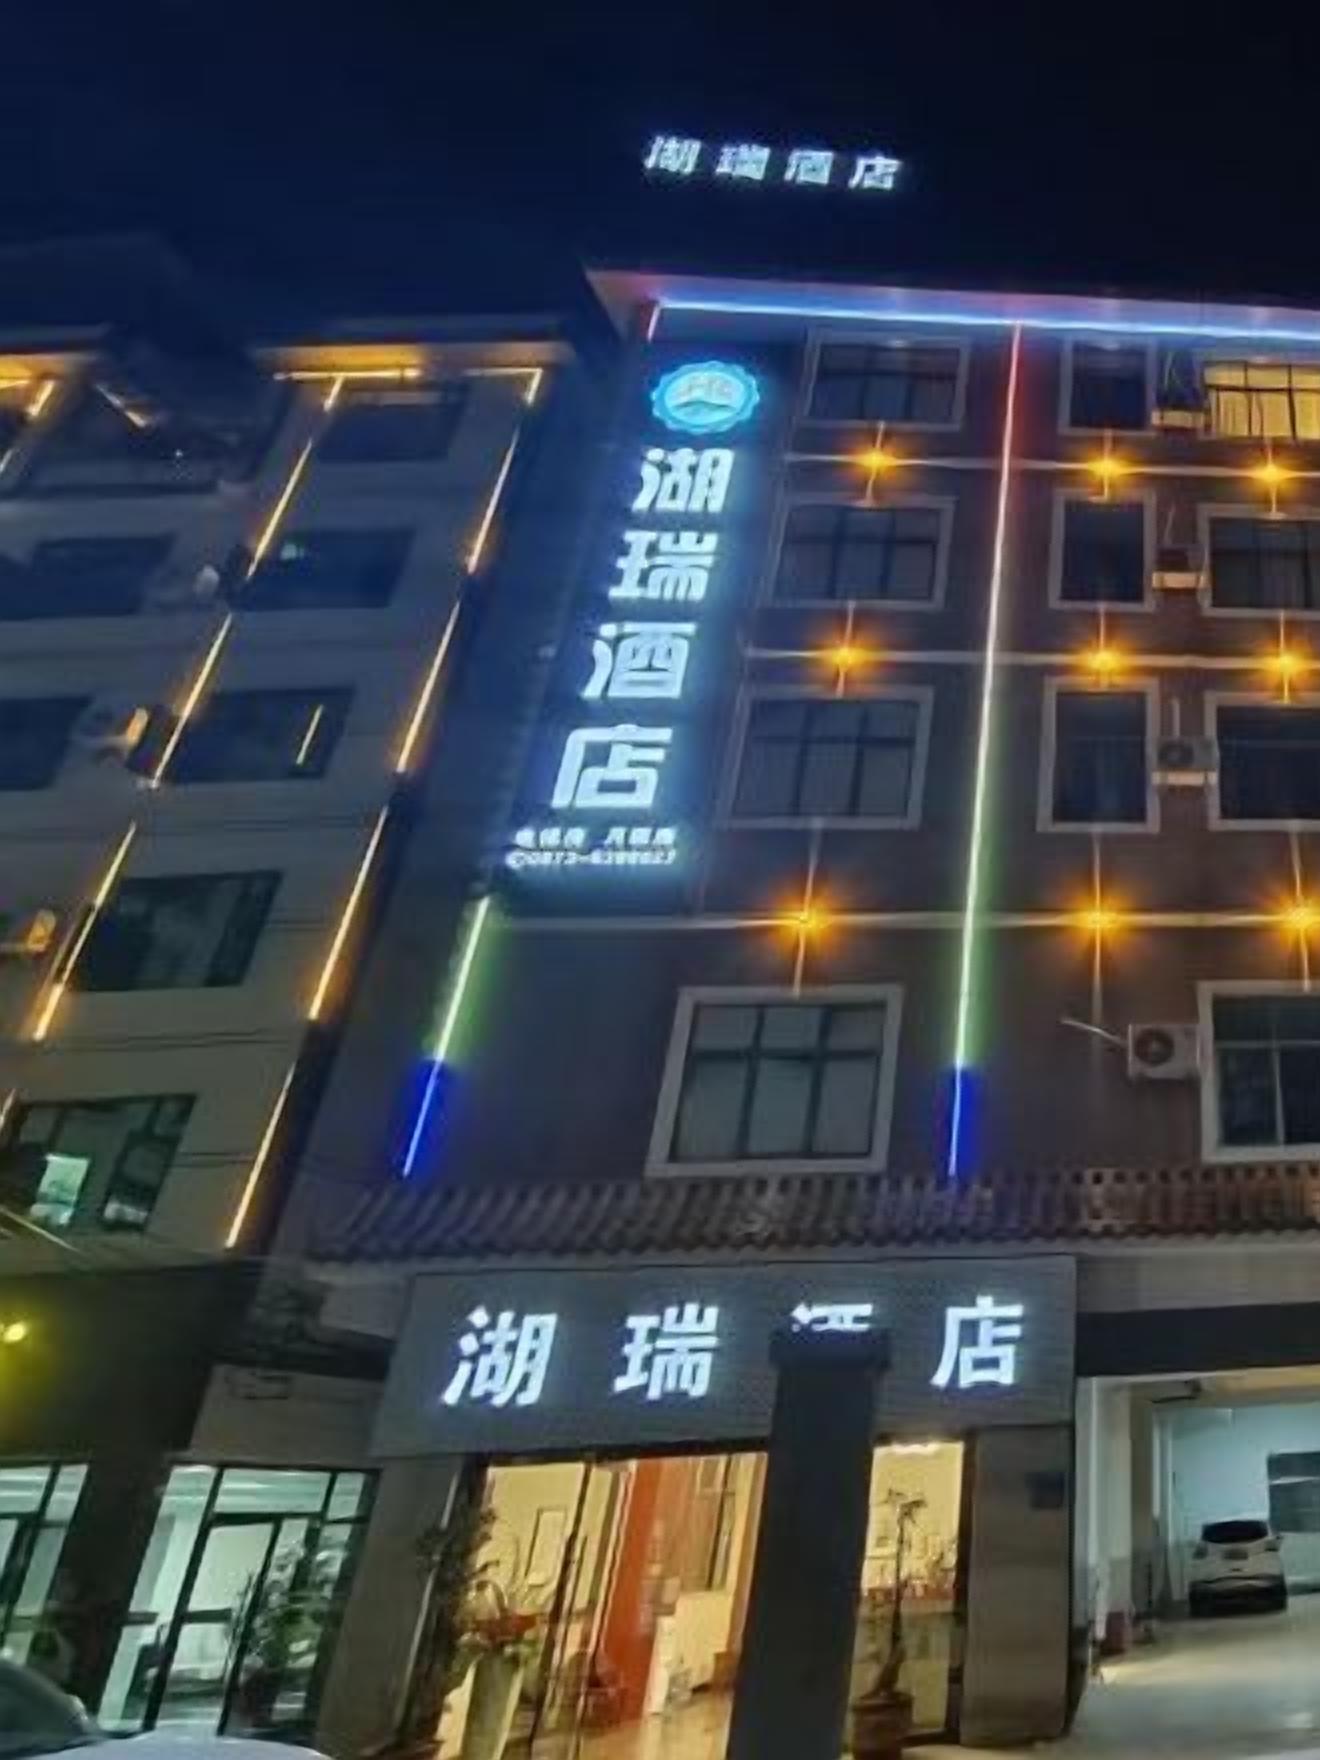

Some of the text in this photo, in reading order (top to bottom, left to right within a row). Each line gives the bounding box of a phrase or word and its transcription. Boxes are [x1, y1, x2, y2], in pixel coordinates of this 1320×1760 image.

[644, 134, 903, 190] 湖瑞酒店
[551, 446, 736, 810] 湖瑞酒店
